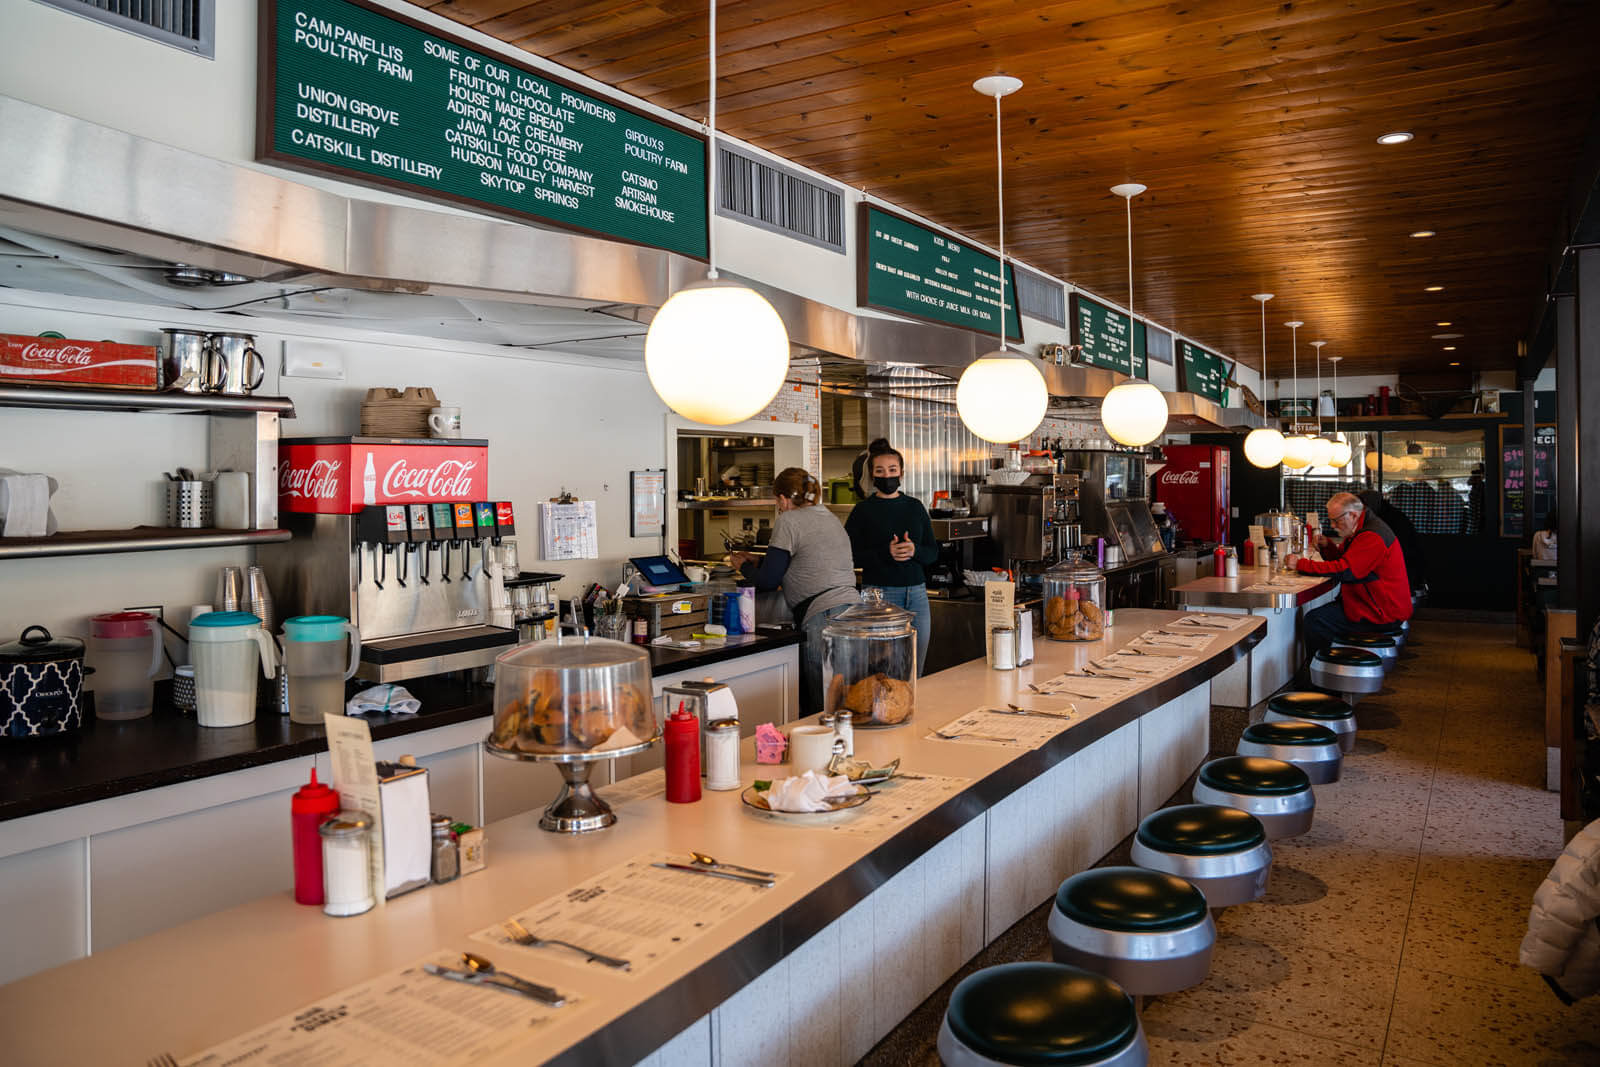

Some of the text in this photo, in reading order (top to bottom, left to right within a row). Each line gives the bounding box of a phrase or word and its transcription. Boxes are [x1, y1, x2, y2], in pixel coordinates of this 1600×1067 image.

[295, 12, 403, 62] CAMPANELLI'S
[295, 29, 413, 82] POULTRY FARM
[423, 40, 616, 123] SOME OF OUR LOCAL PROVIDERS
[450, 68, 575, 124] FRUITION CHOCOLATE
[297, 103, 380, 139] DISTILLERY
[298, 82, 399, 126] UNION GROVE
[449, 83, 564, 133] HOUSE MADE BREAD
[291, 128, 443, 180] CATSKILL DISTILLERY
[445, 128, 593, 184] CATSKILL FOOD COMPANY
[457, 118, 567, 162] JAVA LOVE COFFEE
[525, 125, 583, 153] CREAMERY
[451, 145, 595, 198] HUDSON VALLEY HARVEST
[624, 143, 688, 175] POULTRY FARM
[480, 172, 579, 209] SKYTOP SPRINGS
[621, 170, 658, 191] CATSMO
[621, 185, 657, 206] ARTISAN
[615, 196, 675, 223] SMOKEHOUSE
[905, 289, 920, 301] WITH
[920, 294, 938, 306] CHOICE
[938, 299, 945, 307] OF
[945, 301, 959, 312] JUICE
[971, 309, 979, 317] OR
[22, 342, 93, 365] Coca-Cola
[382, 459, 478, 497] Coca-Cola
[1161, 470, 1200, 484] Coca-Cola
